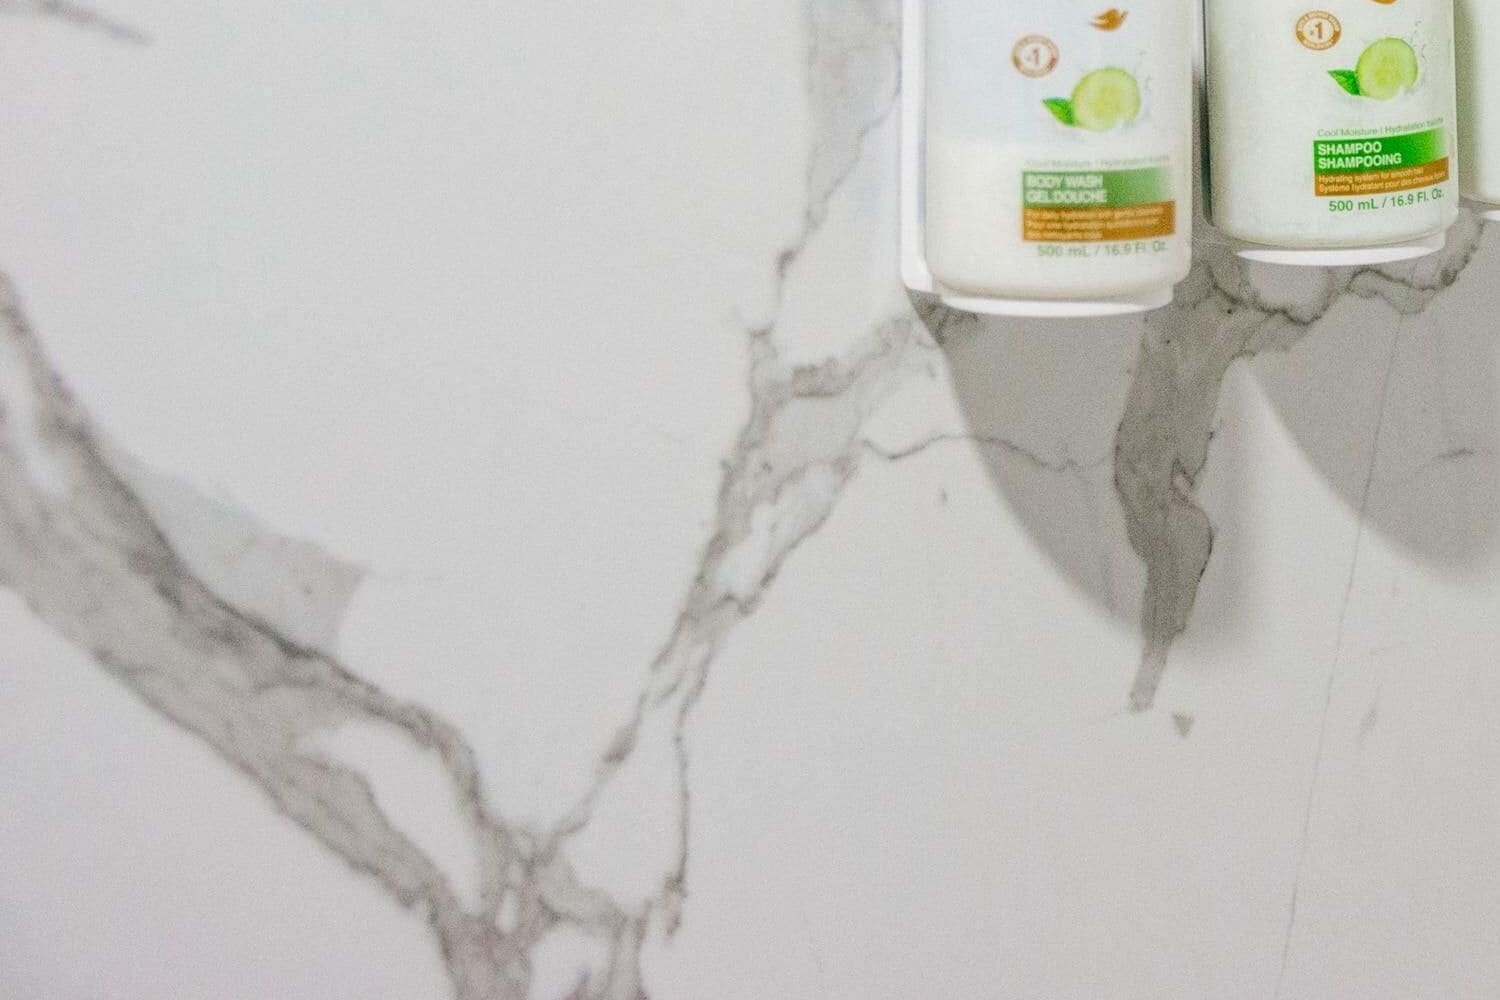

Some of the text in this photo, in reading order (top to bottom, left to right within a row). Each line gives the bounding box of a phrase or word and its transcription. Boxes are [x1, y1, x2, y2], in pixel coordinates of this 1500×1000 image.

[1318, 141, 1382, 155] SHAMPOO
[1318, 153, 1402, 169] SHAMPOOING
[1328, 200, 1353, 212] 500
[1358, 198, 1378, 210] mL
[1391, 193, 1414, 207] 16.9
[1038, 245, 1063, 257] 500
[1069, 245, 1088, 256] mL
